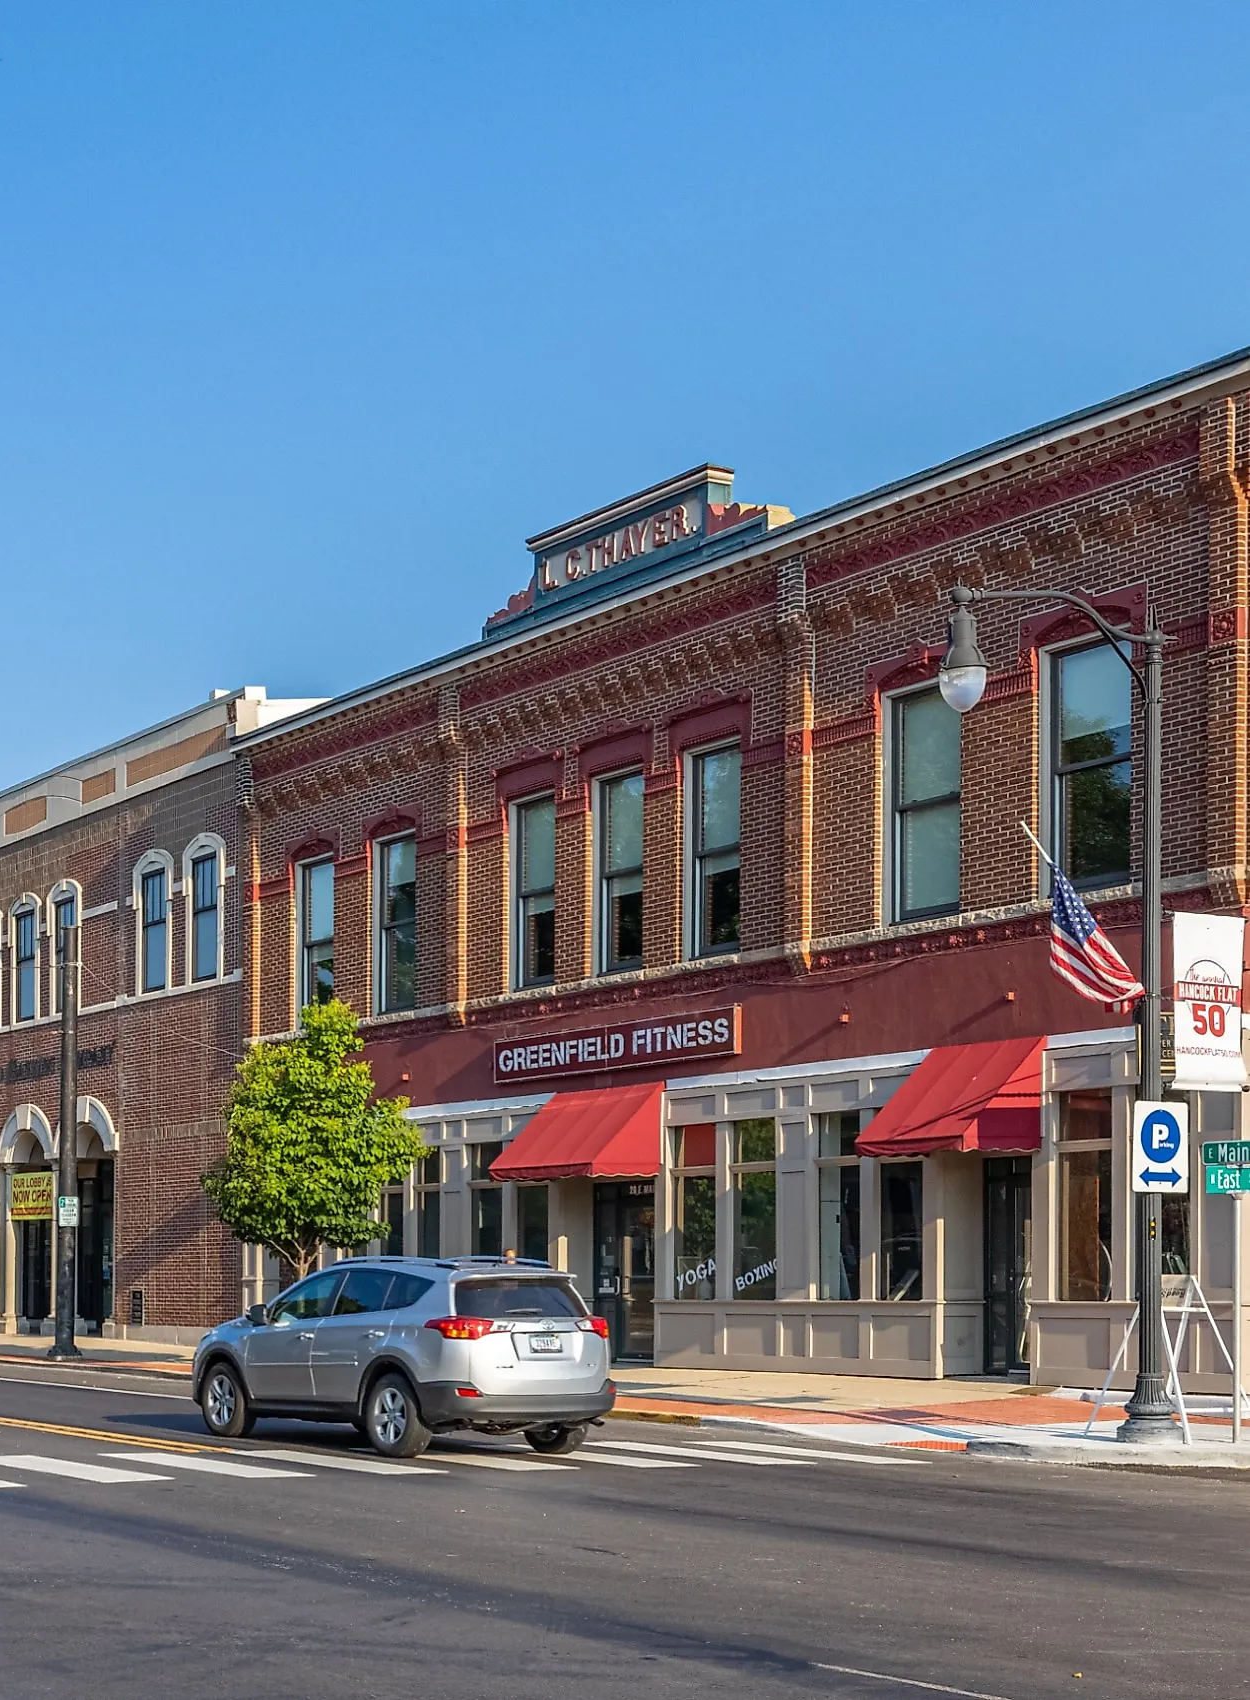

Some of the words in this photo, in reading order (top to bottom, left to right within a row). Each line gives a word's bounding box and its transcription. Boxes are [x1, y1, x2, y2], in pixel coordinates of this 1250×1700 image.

[1179, 984, 1215, 1001] HANCOCK
[1217, 987, 1238, 1003] FLAT
[1192, 1003, 1225, 1037] 50
[499, 1033, 625, 1073] GREENFIELD
[632, 1018, 730, 1056] FITNESS
[1208, 1147, 1214, 1159] E
[1218, 1142, 1250, 1163] Main
[13, 1179, 25, 1188] OUR
[26, 1177, 46, 1188] LOBBY
[1217, 1169, 1241, 1189] East
[13, 1190, 30, 1203] NOW
[31, 1189, 52, 1202] OPEN
[677, 1259, 717, 1292] YOGA
